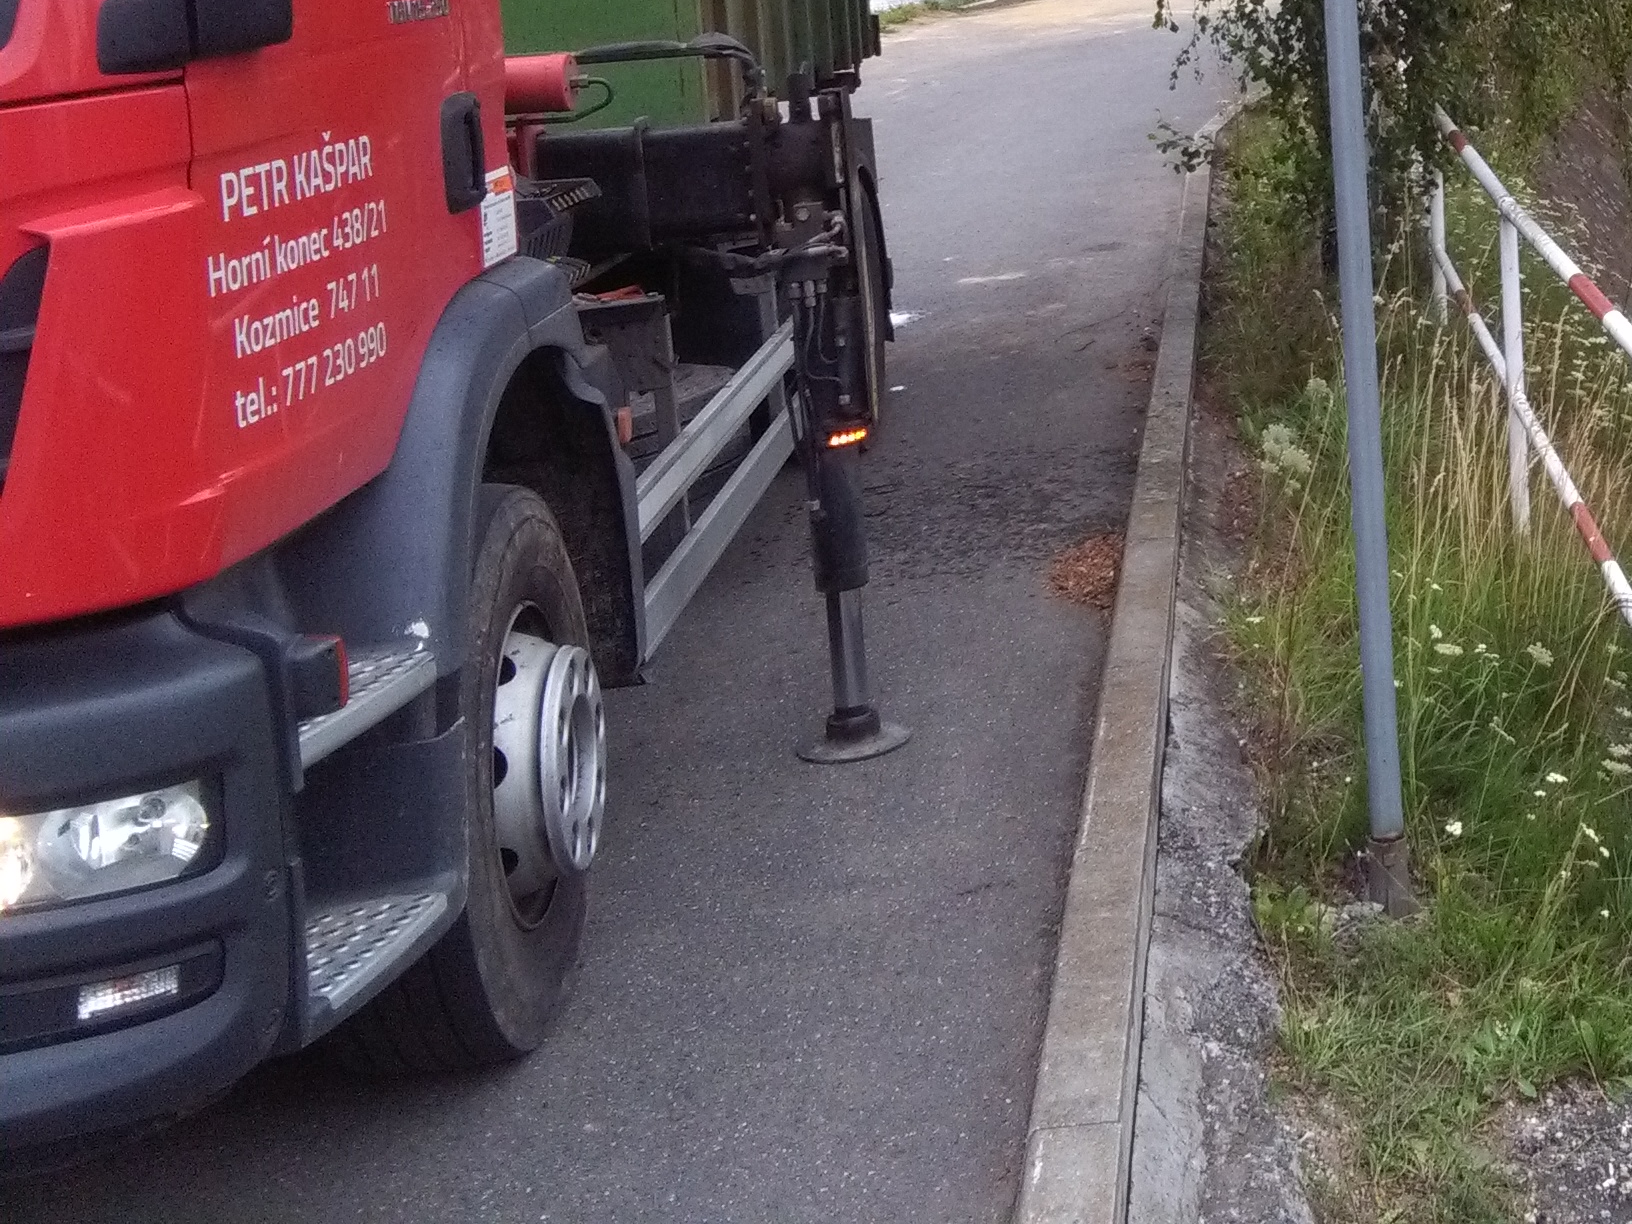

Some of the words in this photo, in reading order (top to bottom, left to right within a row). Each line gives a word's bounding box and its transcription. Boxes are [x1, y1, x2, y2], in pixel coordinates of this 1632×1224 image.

[220, 159, 289, 222] PETR
[294, 131, 373, 200] KAŠPAR
[208, 235, 271, 297] Horní
[275, 228, 330, 275] konec
[332, 199, 387, 251] 438/21
[235, 295, 320, 359] Kozmice
[327, 272, 357, 319] 747
[361, 264, 380, 302] 11
[282, 356, 318, 407] 777
[323, 338, 355, 386] 230
[359, 321, 387, 369] 990
